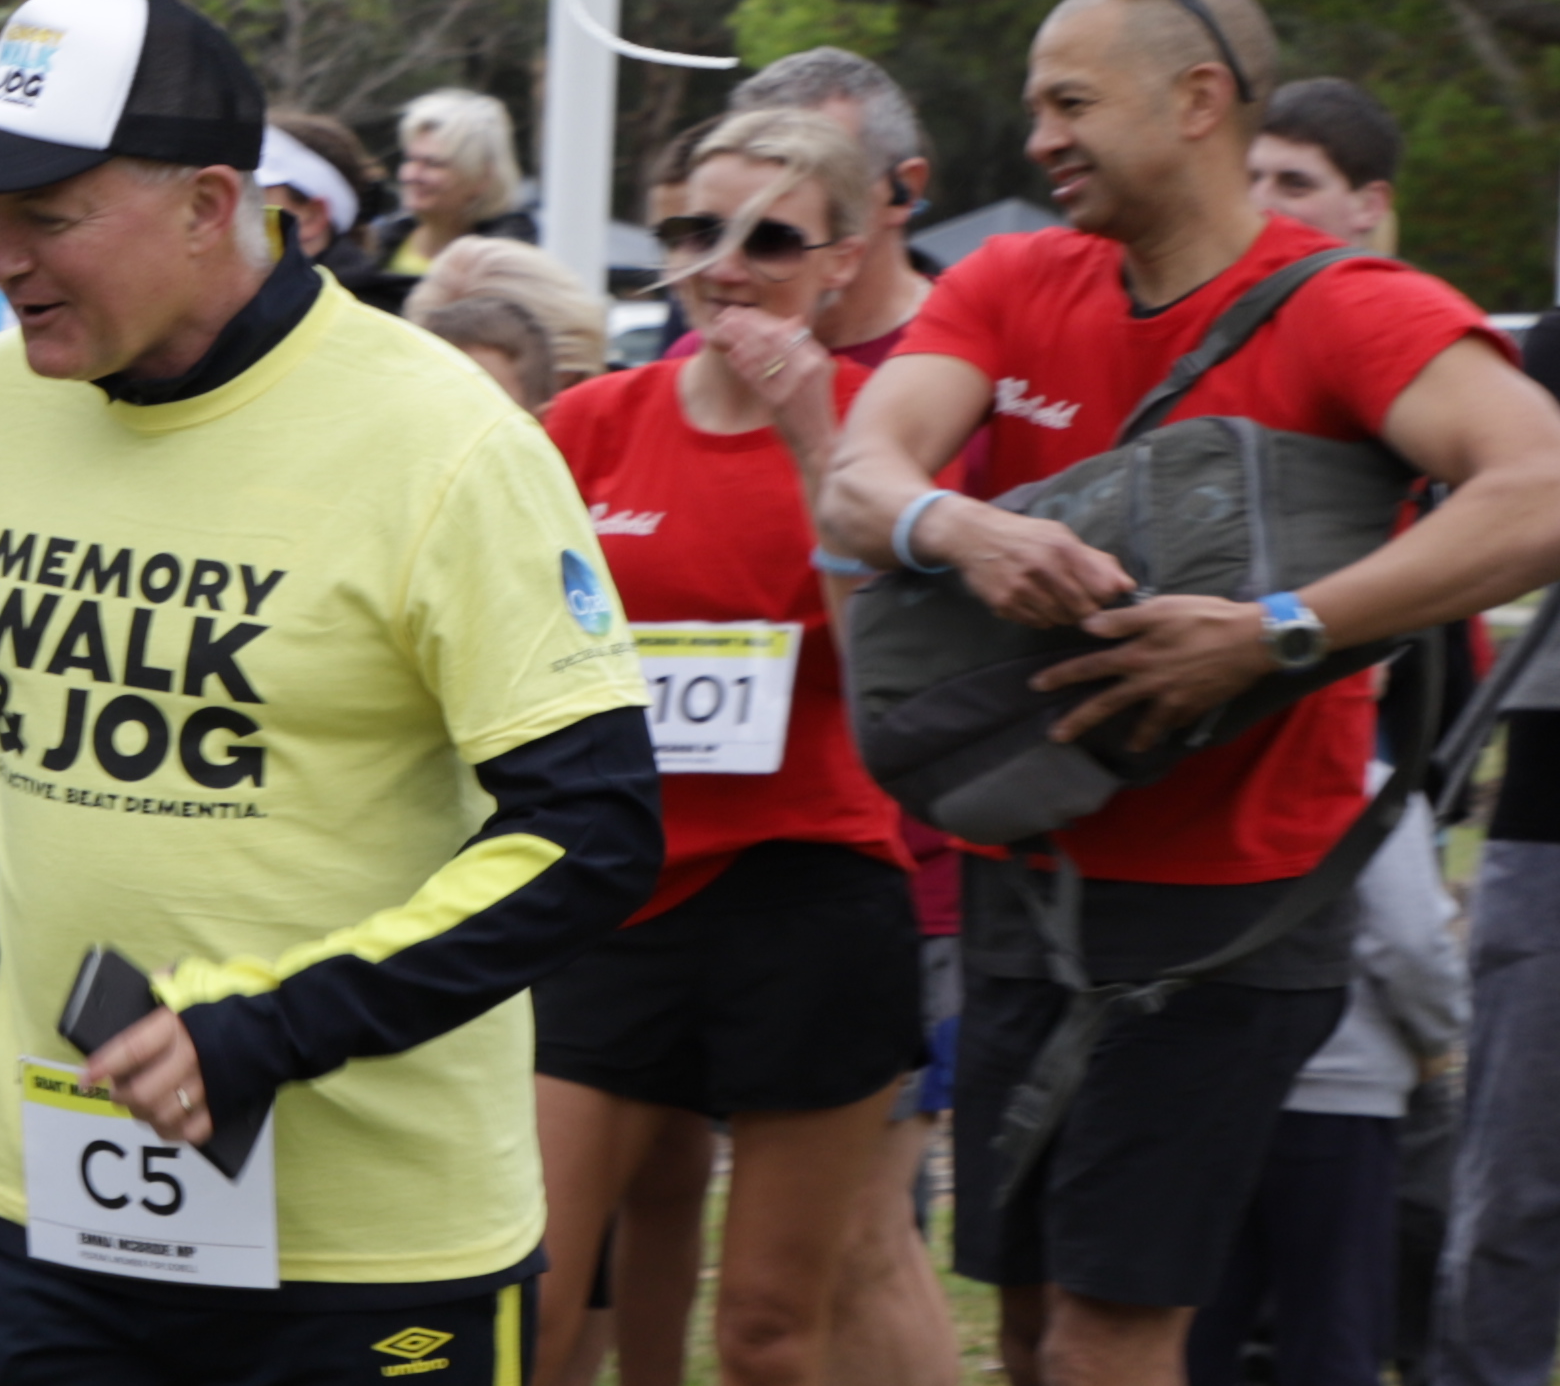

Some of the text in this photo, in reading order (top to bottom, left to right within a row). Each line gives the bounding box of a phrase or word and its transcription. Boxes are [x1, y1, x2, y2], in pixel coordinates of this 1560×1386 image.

[648, 673, 758, 725] 101
[41, 687, 268, 790] JOG
[65, 786, 120, 812] BEAT
[124, 796, 267, 820] DEMENTIA.
[80, 1139, 186, 1217] C5
[380, 1357, 450, 1378] umbro
